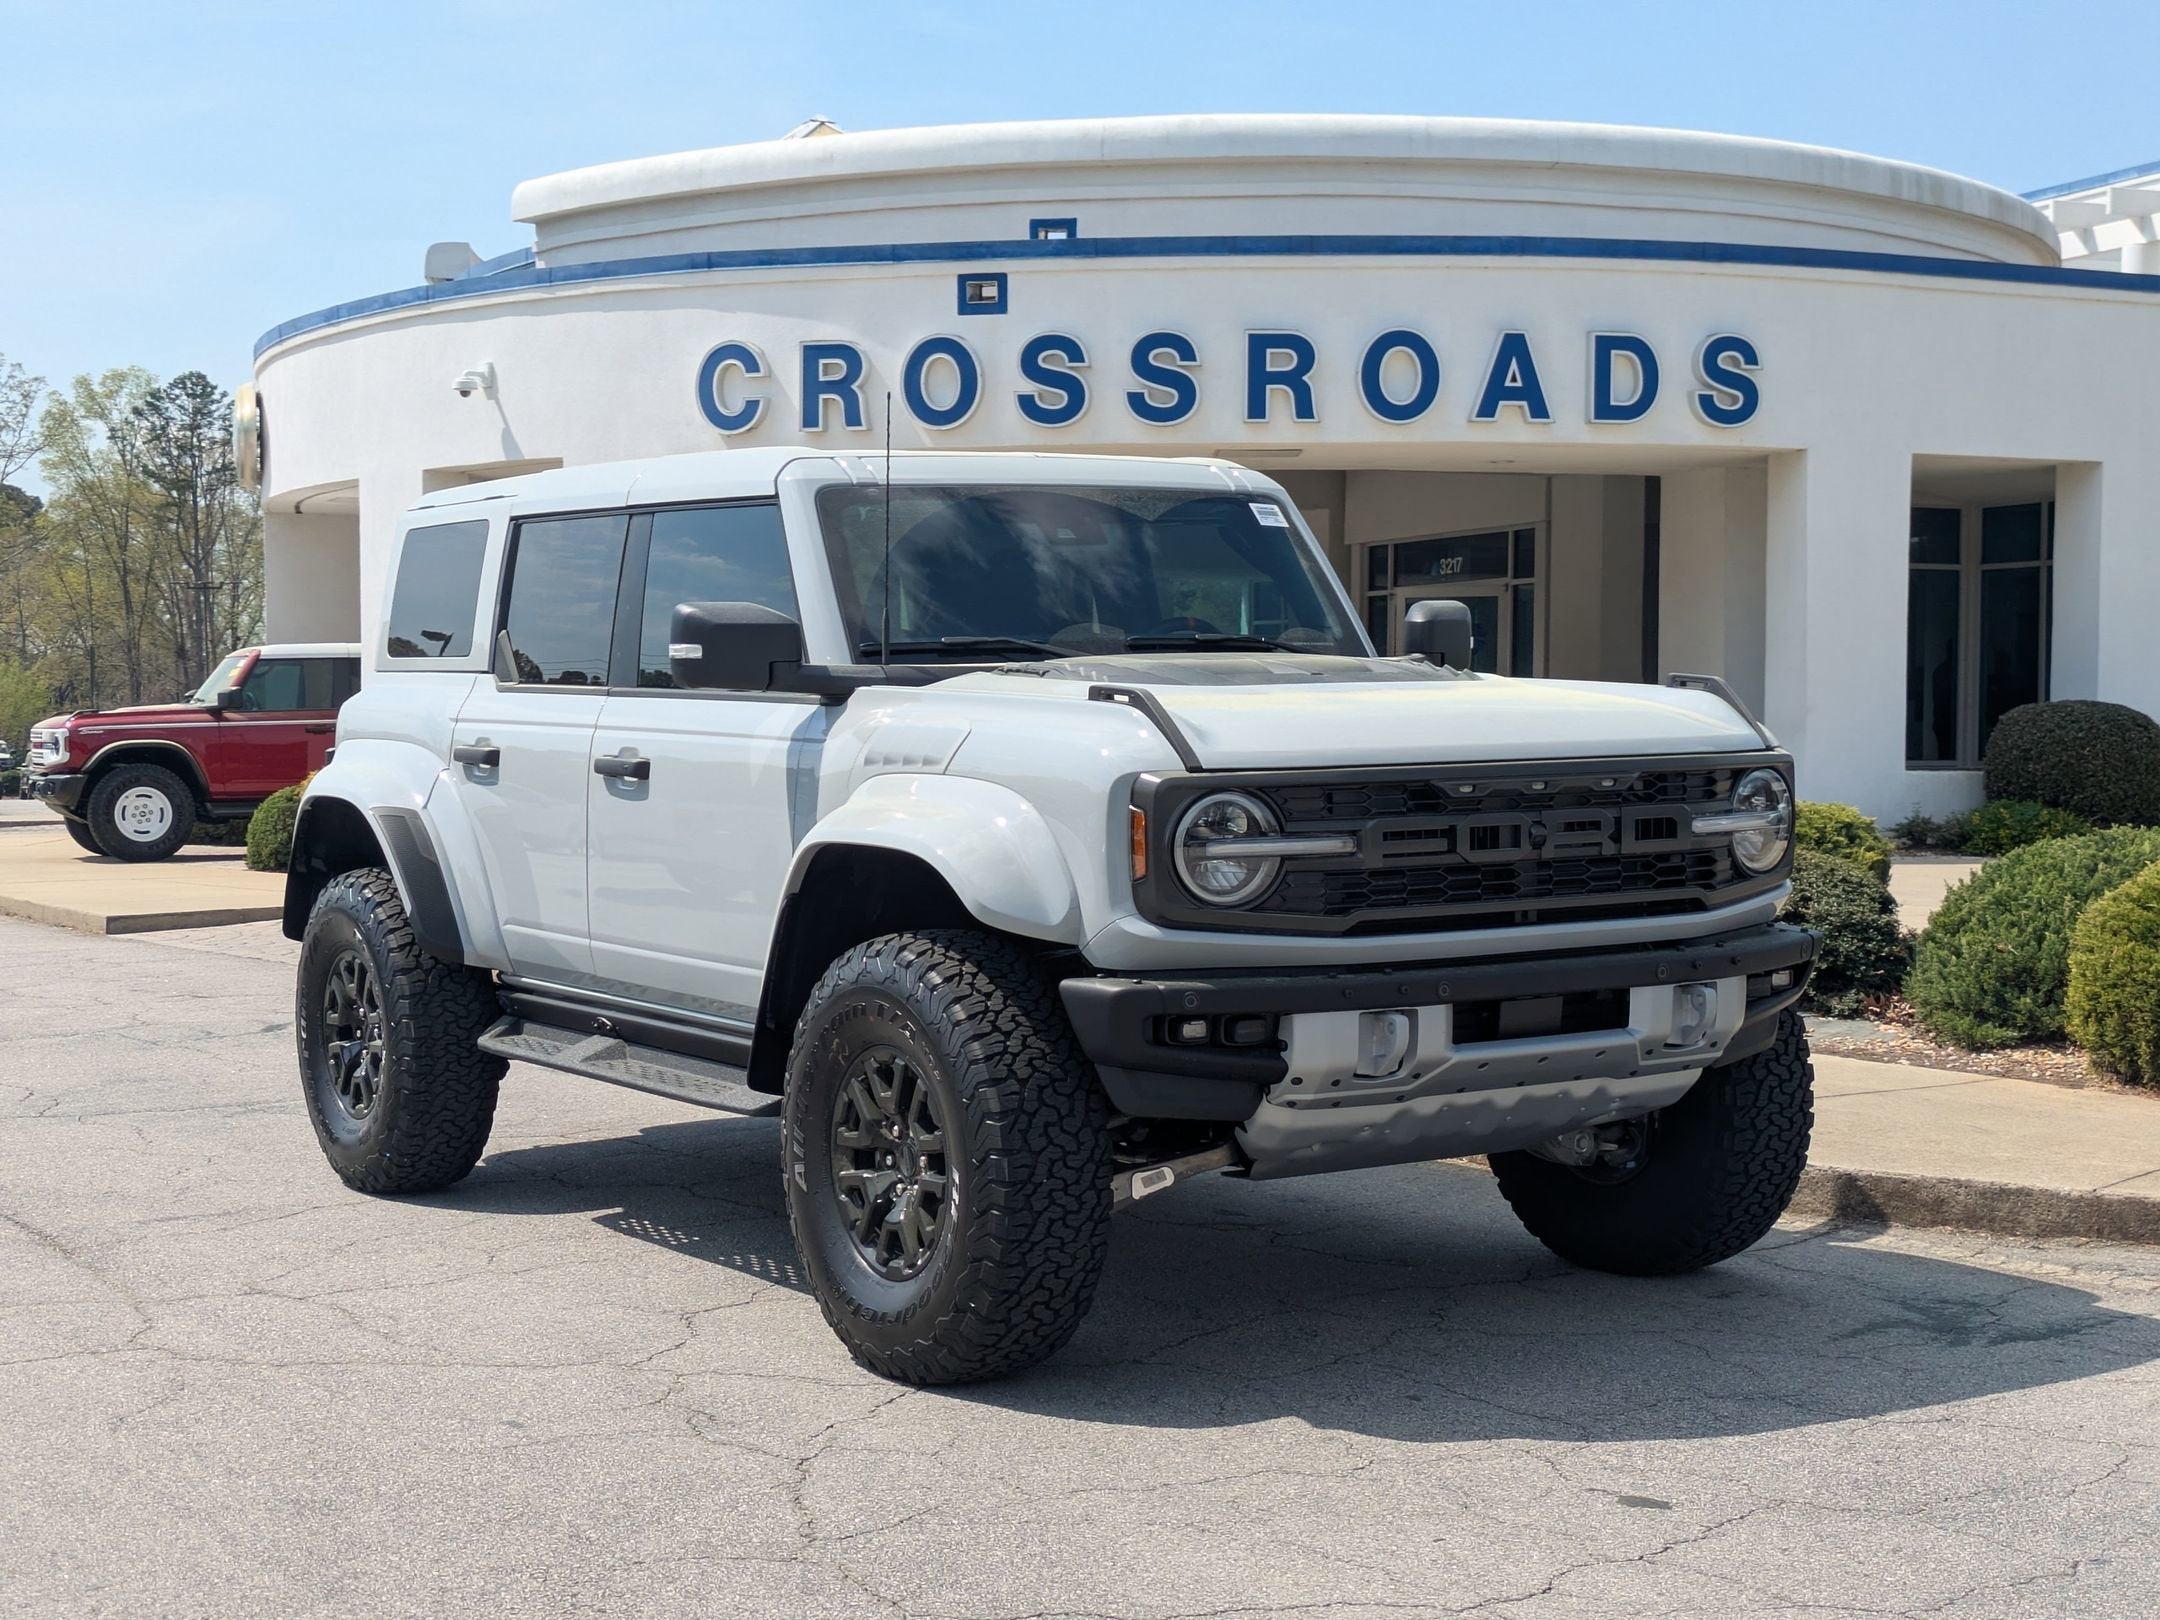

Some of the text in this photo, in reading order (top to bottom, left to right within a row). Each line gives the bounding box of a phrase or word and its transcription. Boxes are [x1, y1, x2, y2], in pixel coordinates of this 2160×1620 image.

[695, 328, 1762, 435] CROSSROADS
[1439, 557, 1463, 575] 3217
[1360, 804, 1692, 868] FORD
